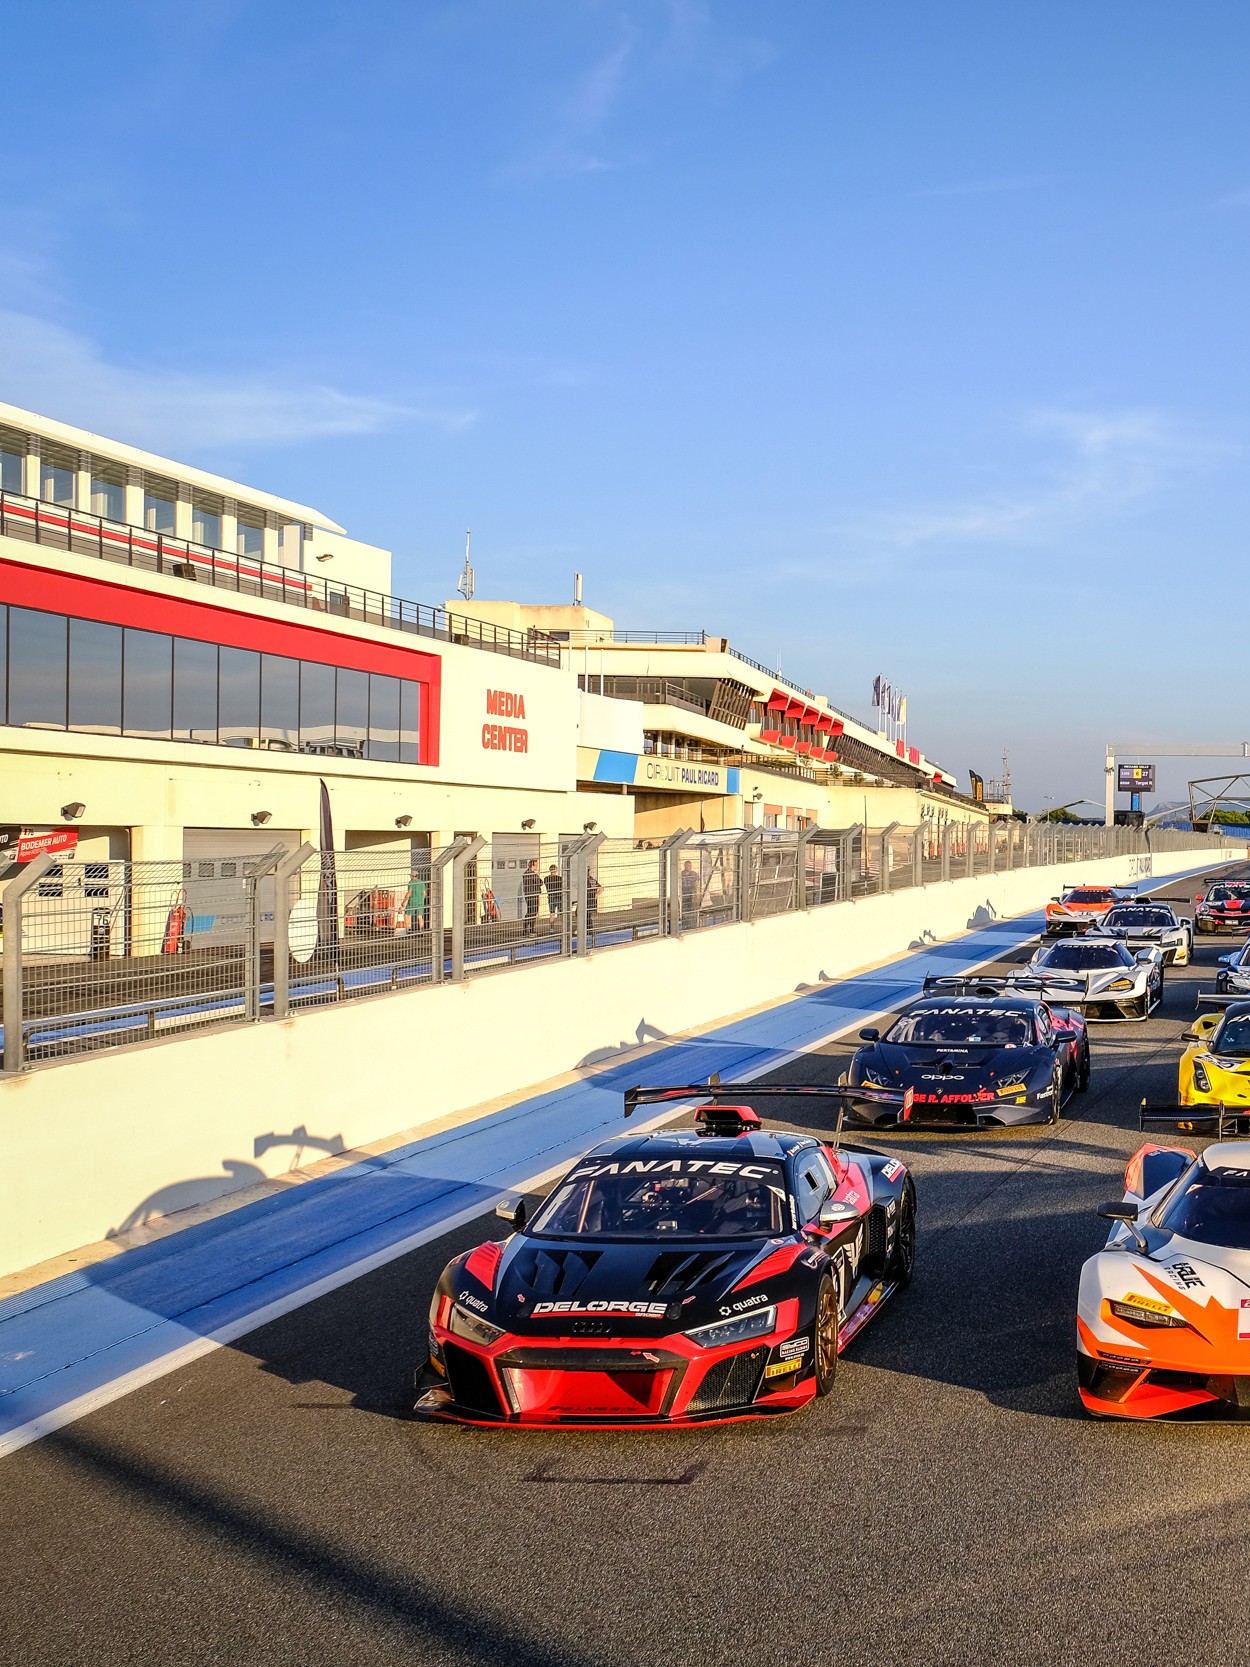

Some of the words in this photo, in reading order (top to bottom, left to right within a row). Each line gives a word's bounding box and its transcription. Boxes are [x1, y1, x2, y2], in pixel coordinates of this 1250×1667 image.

[486, 688, 526, 720] MEDIA
[482, 723, 529, 754] CENTER
[681, 767, 697, 785] PAUL
[697, 769, 720, 787] RICARD
[20, 836, 53, 851] BODEMER
[52, 834, 68, 844] AUTO
[909, 1008, 1026, 1017] FANATEC
[566, 1159, 778, 1184] FANATEC
[1163, 1266, 1186, 1291] RACING
[466, 1292, 489, 1313] quatra
[532, 1300, 668, 1314] DELORGE
[731, 1292, 769, 1312] quatra
[1127, 1294, 1171, 1312] PIRELLI
[766, 1358, 802, 1377] PIRELLI
